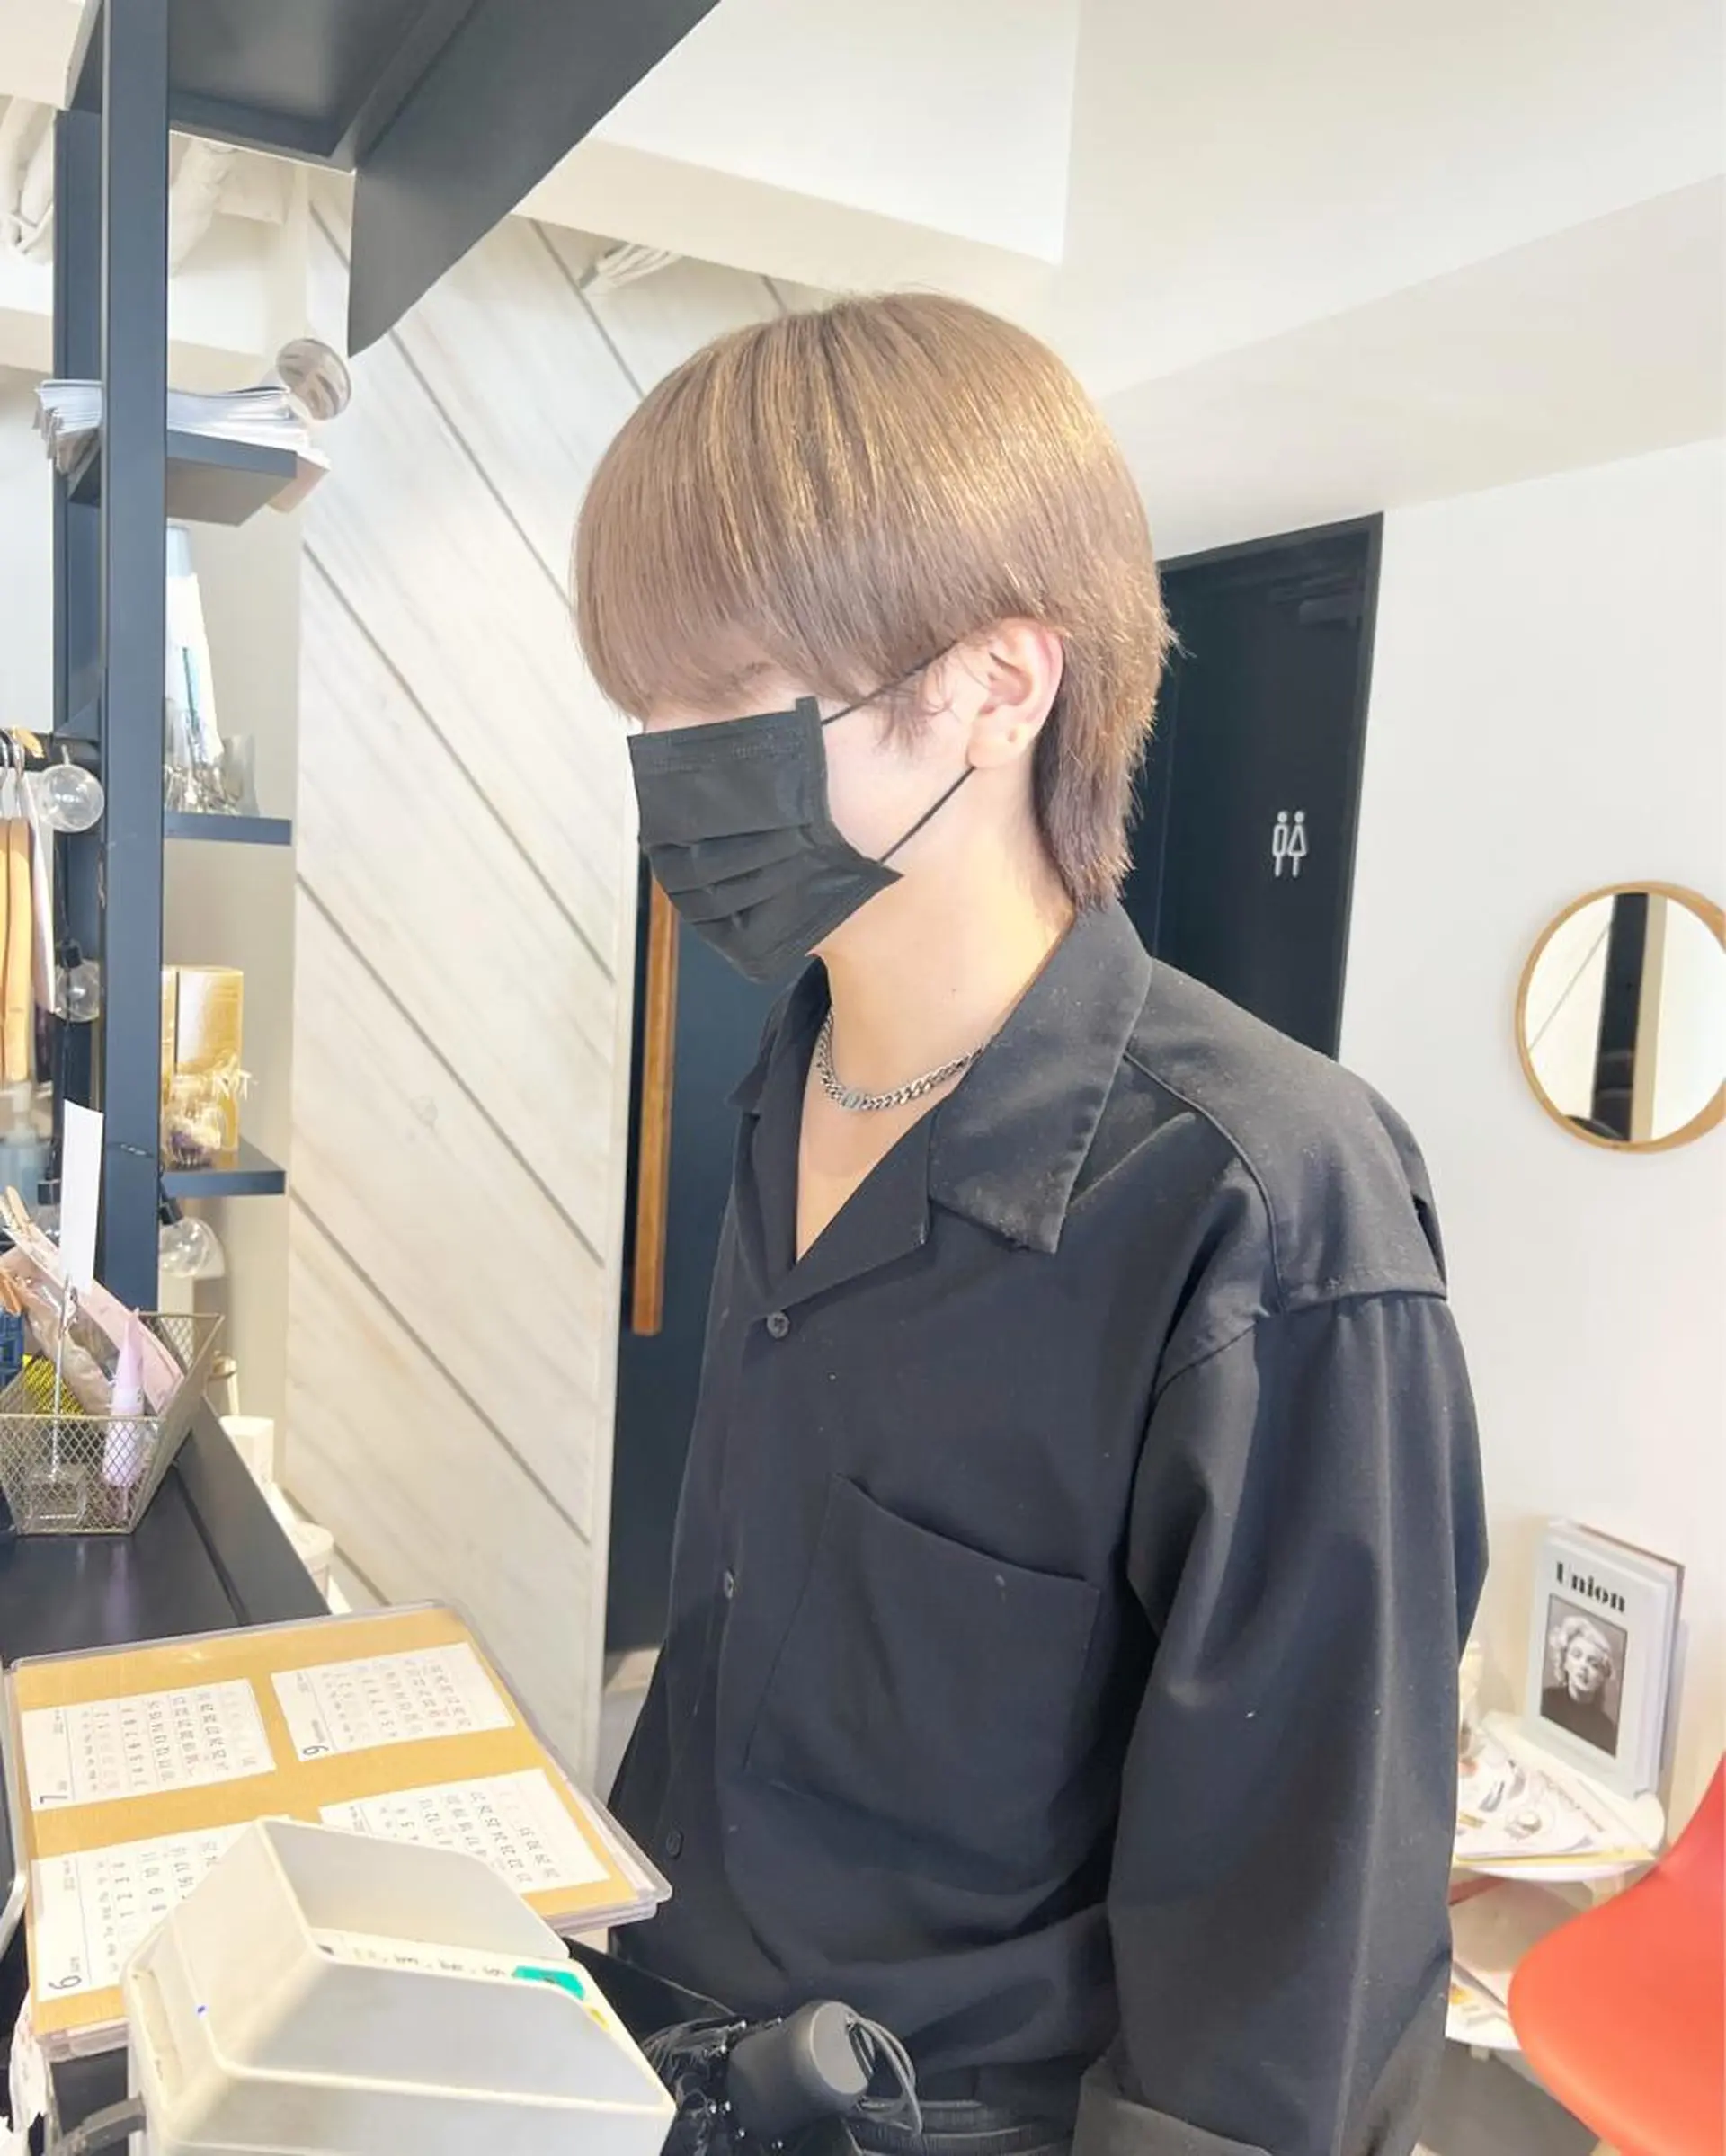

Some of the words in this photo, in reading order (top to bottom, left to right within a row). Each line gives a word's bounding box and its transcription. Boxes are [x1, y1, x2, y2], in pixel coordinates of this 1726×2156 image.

[1556, 1561, 1625, 1613] Union
[302, 1745, 330, 1756] 9
[39, 1795, 68, 1805] 7
[47, 1974, 83, 1990] 6
